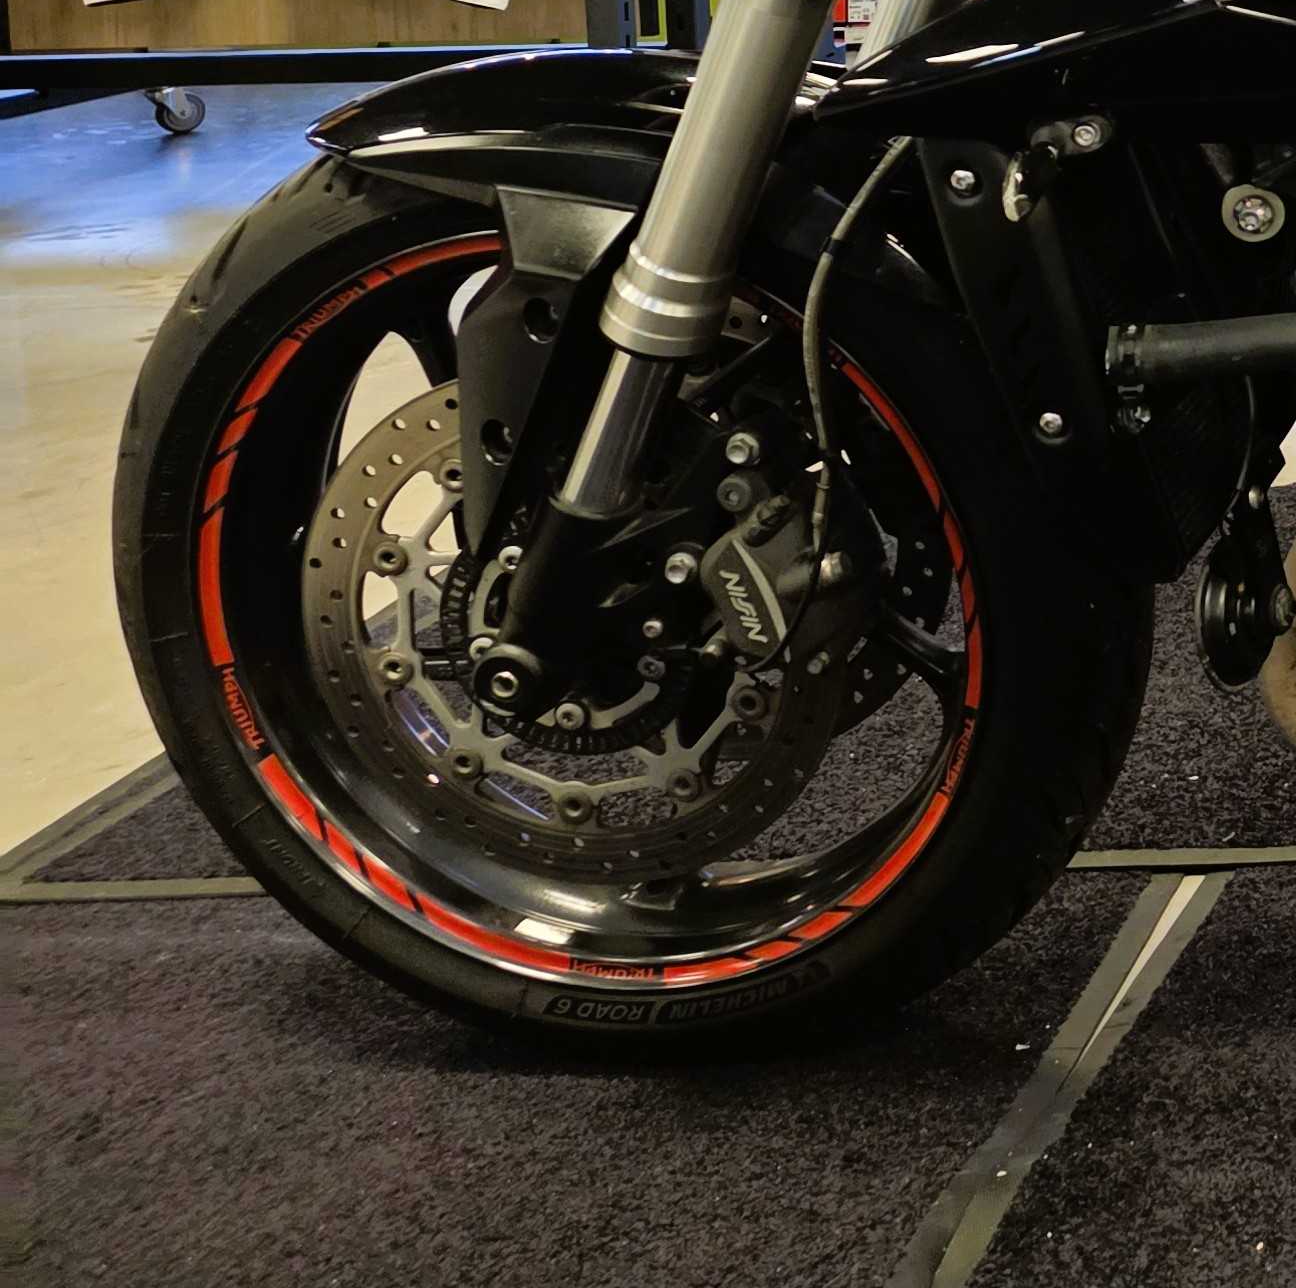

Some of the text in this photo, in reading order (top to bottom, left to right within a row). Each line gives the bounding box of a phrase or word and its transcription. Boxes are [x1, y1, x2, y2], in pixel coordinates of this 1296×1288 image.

[715, 568, 768, 647] NISSIN
[554, 997, 570, 1014] 6
[577, 999, 645, 1021] ROAD
